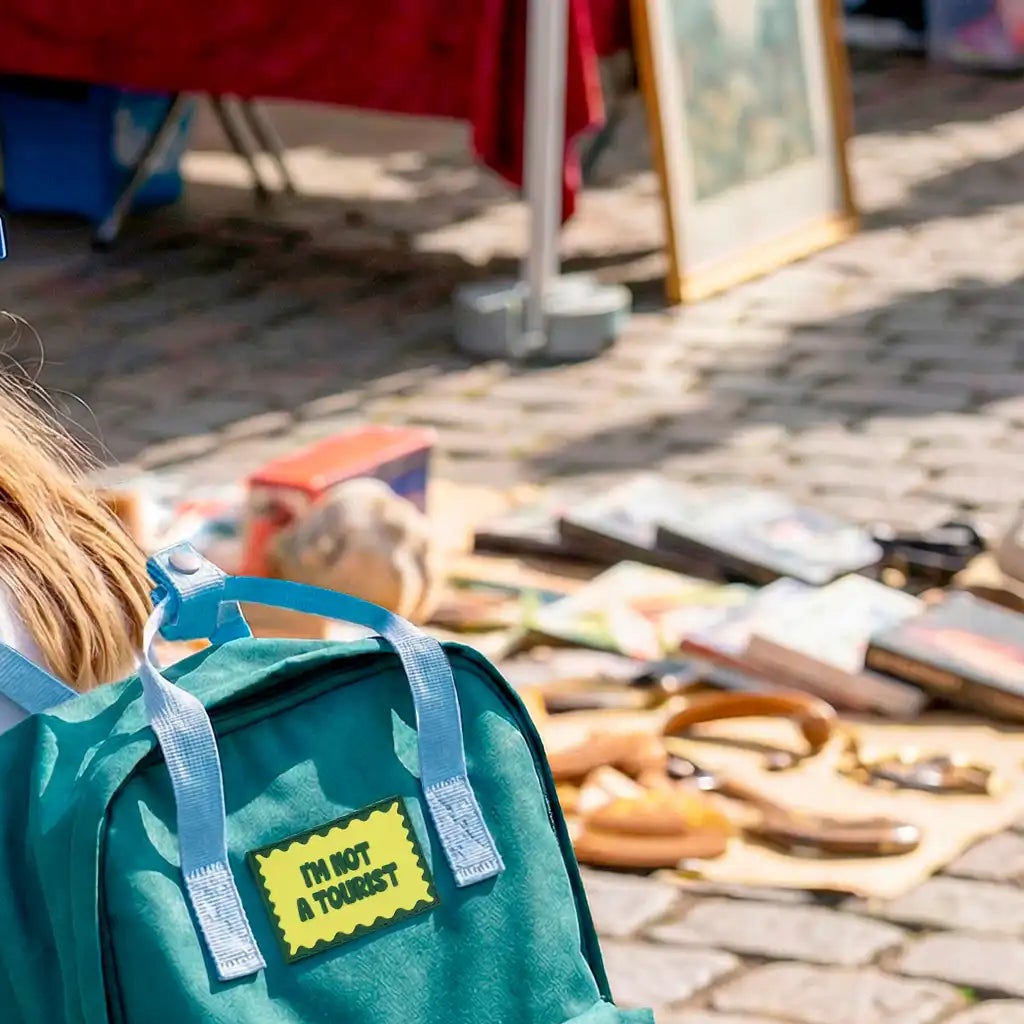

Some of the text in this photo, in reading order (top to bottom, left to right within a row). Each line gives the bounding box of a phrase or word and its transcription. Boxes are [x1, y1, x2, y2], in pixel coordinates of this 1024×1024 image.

[299, 841, 371, 888] I'M NOT
[296, 862, 399, 922] A TOURIST
